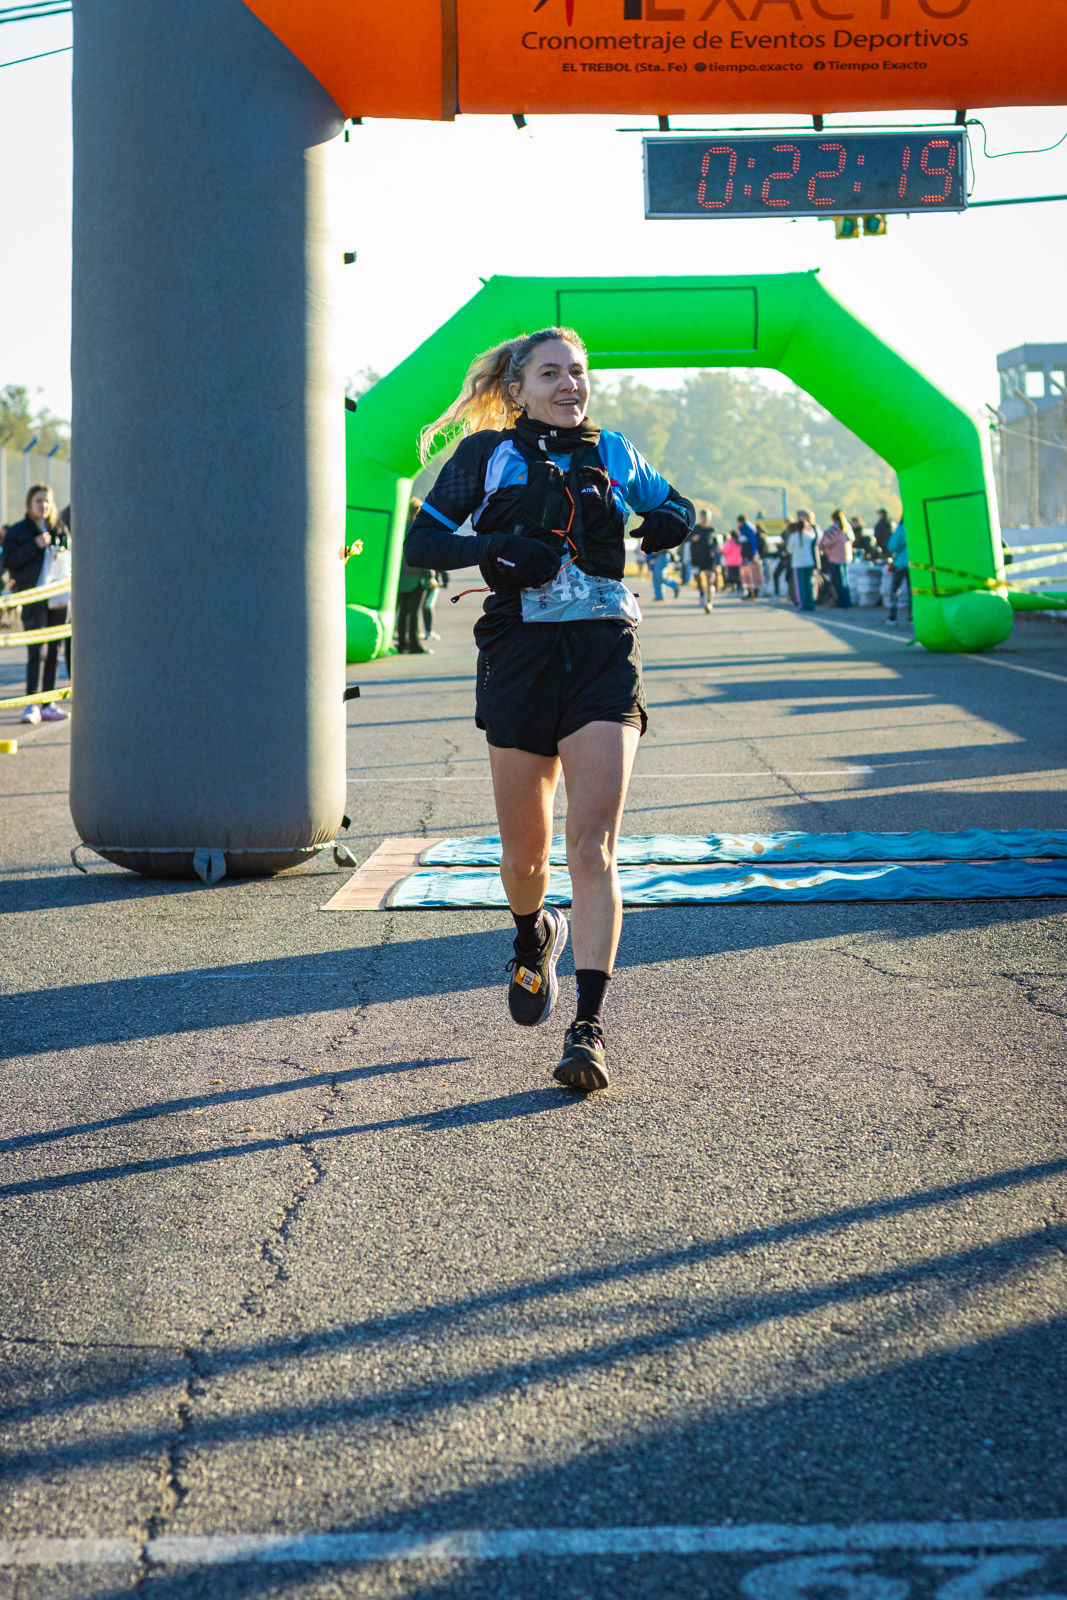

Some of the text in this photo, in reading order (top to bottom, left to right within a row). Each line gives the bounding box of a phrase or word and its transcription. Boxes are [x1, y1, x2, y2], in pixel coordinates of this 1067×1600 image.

[521, 29, 969, 54] Cronometraje de Eventos Deportivos
[562, 60, 928, 73] EL TREBOL (Sta. Fe) tiempo.exacto Tiempo Exacto
[698, 140, 956, 209] 0:22:19
